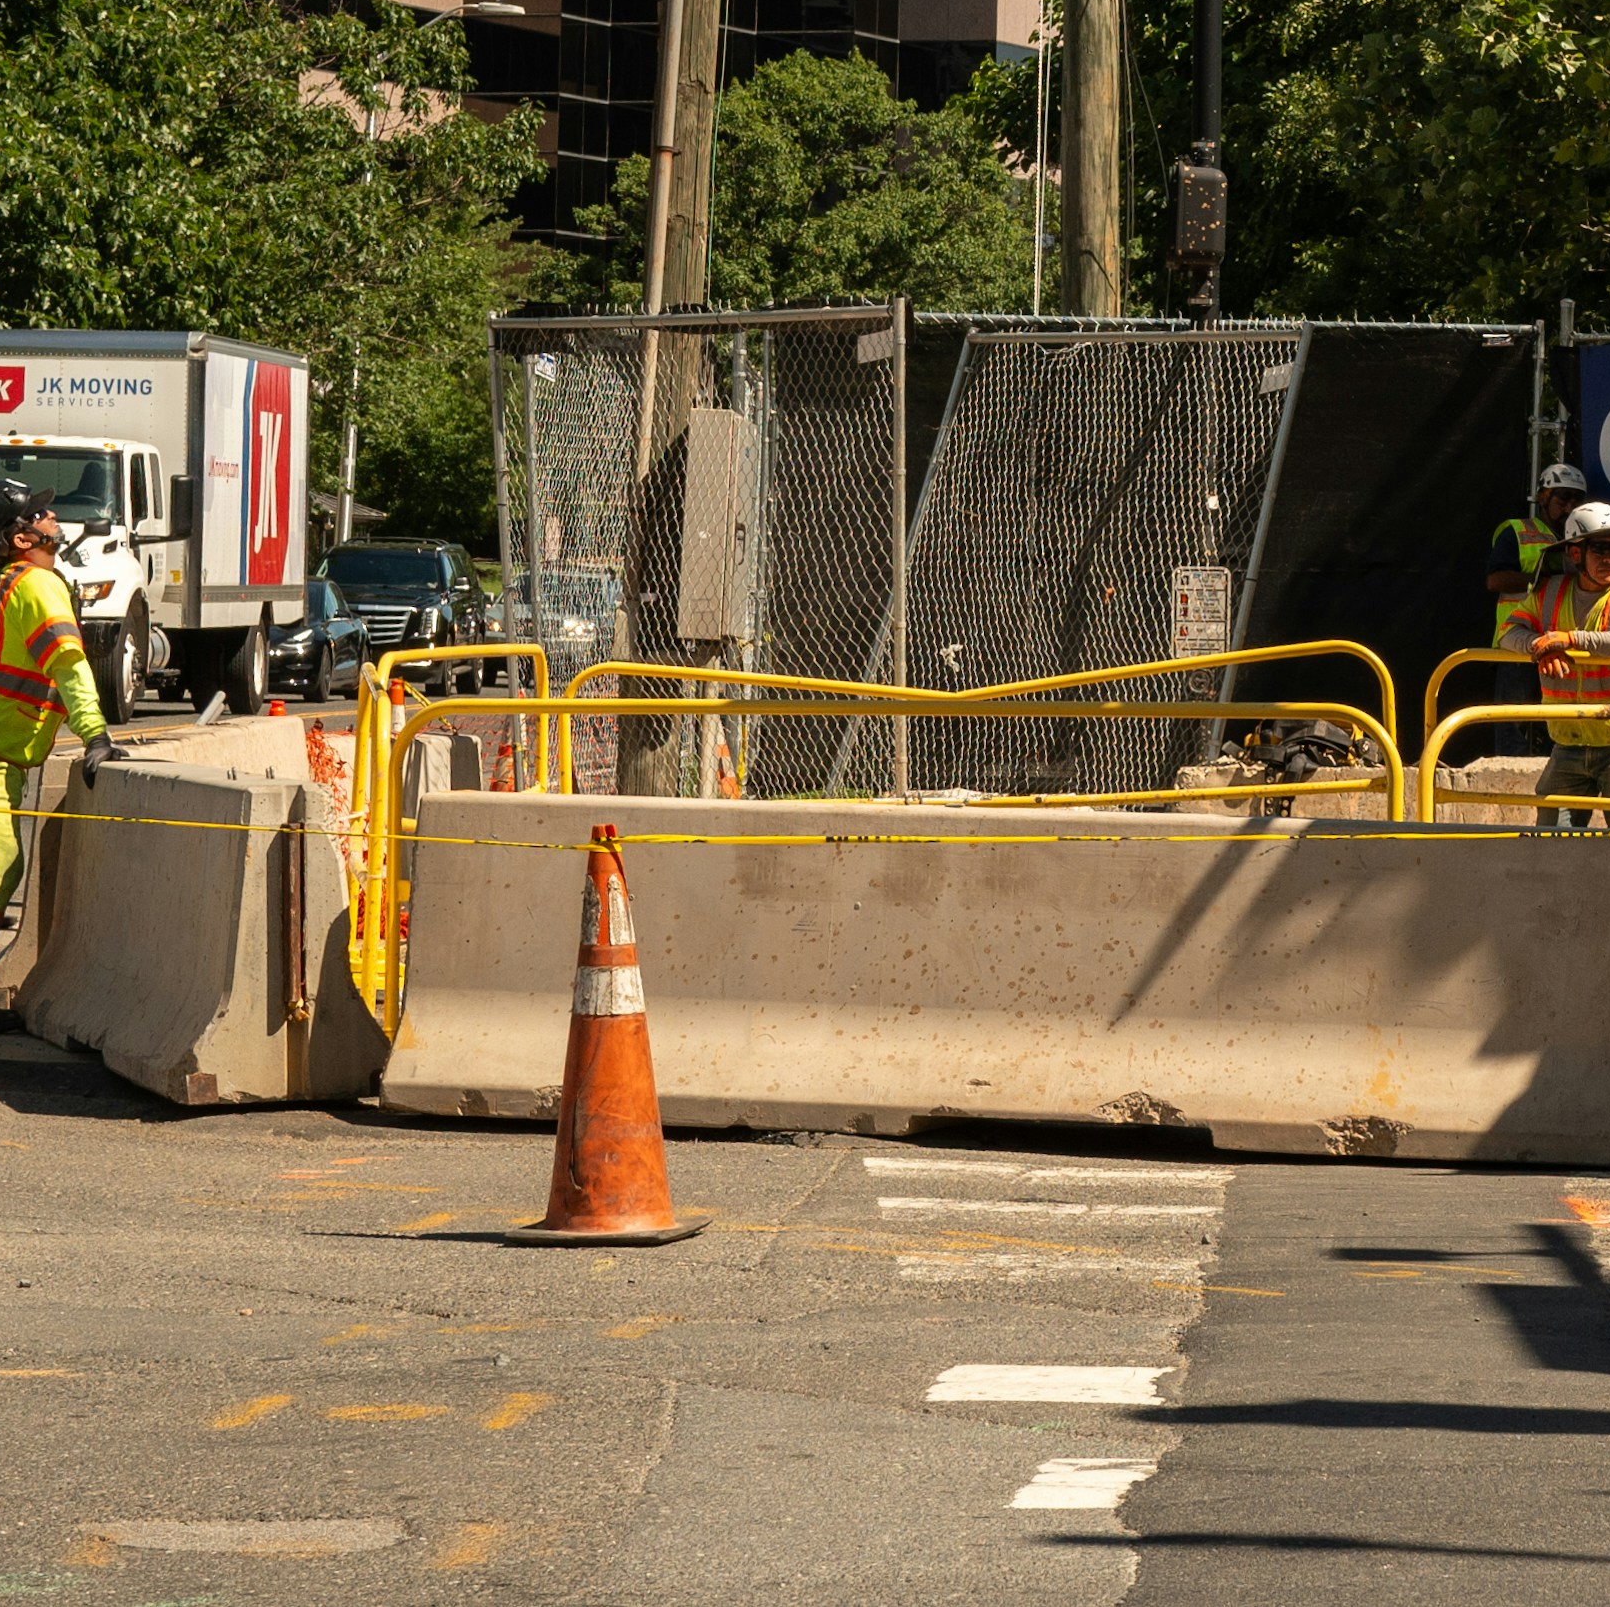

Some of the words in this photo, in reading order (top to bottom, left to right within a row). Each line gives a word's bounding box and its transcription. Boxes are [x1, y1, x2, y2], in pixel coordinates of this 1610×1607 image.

[36, 377, 63, 395] JK
[70, 378, 153, 396] MOVING
[36, 396, 116, 408] SERVICES
[254, 410, 283, 554] JK
